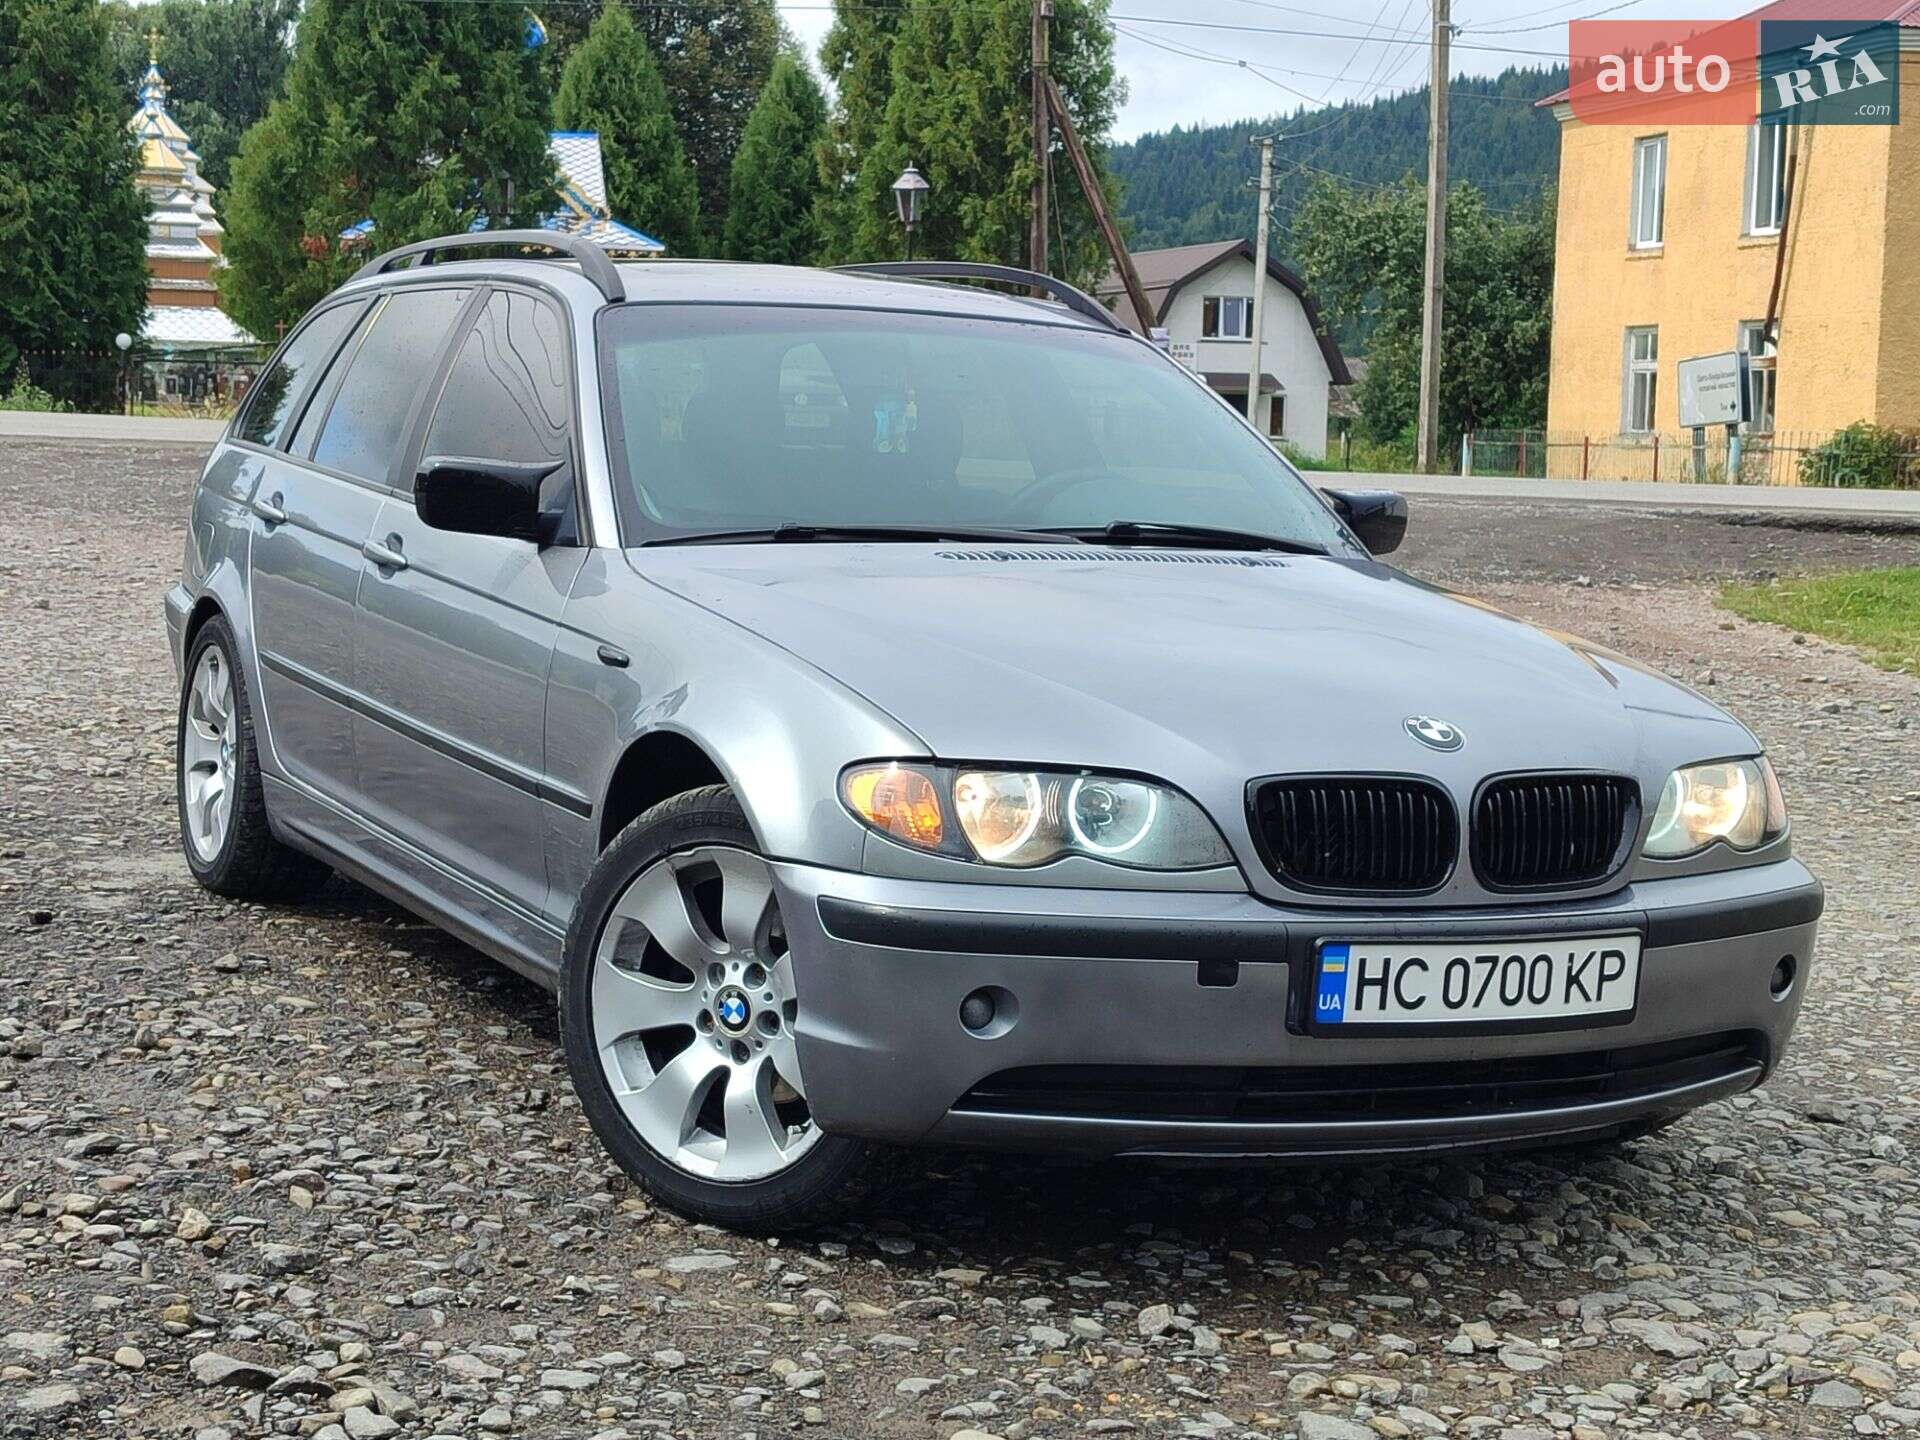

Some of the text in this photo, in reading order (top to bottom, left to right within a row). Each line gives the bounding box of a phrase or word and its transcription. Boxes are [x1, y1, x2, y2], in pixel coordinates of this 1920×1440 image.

[1354, 950, 1626, 1010] HC 0700 KP
[1319, 993, 1342, 1011] UA
